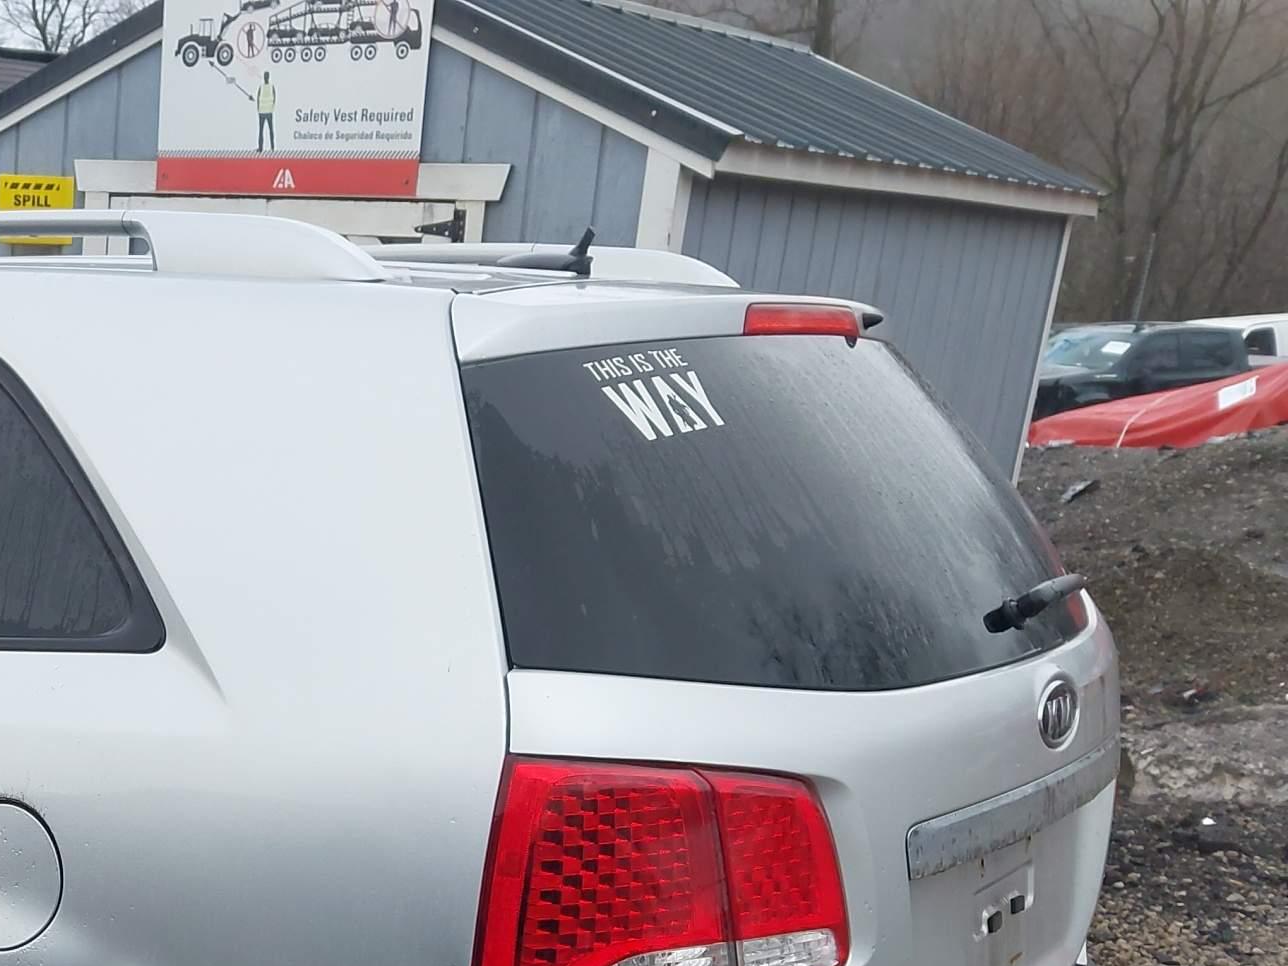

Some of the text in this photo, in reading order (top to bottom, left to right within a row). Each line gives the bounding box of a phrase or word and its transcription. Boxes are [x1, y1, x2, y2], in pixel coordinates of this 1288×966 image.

[295, 108, 414, 125] Safety Vest Required
[13, 194, 51, 208] SPILL
[583, 348, 688, 382] THIS IS THE
[601, 370, 725, 441] WAY
